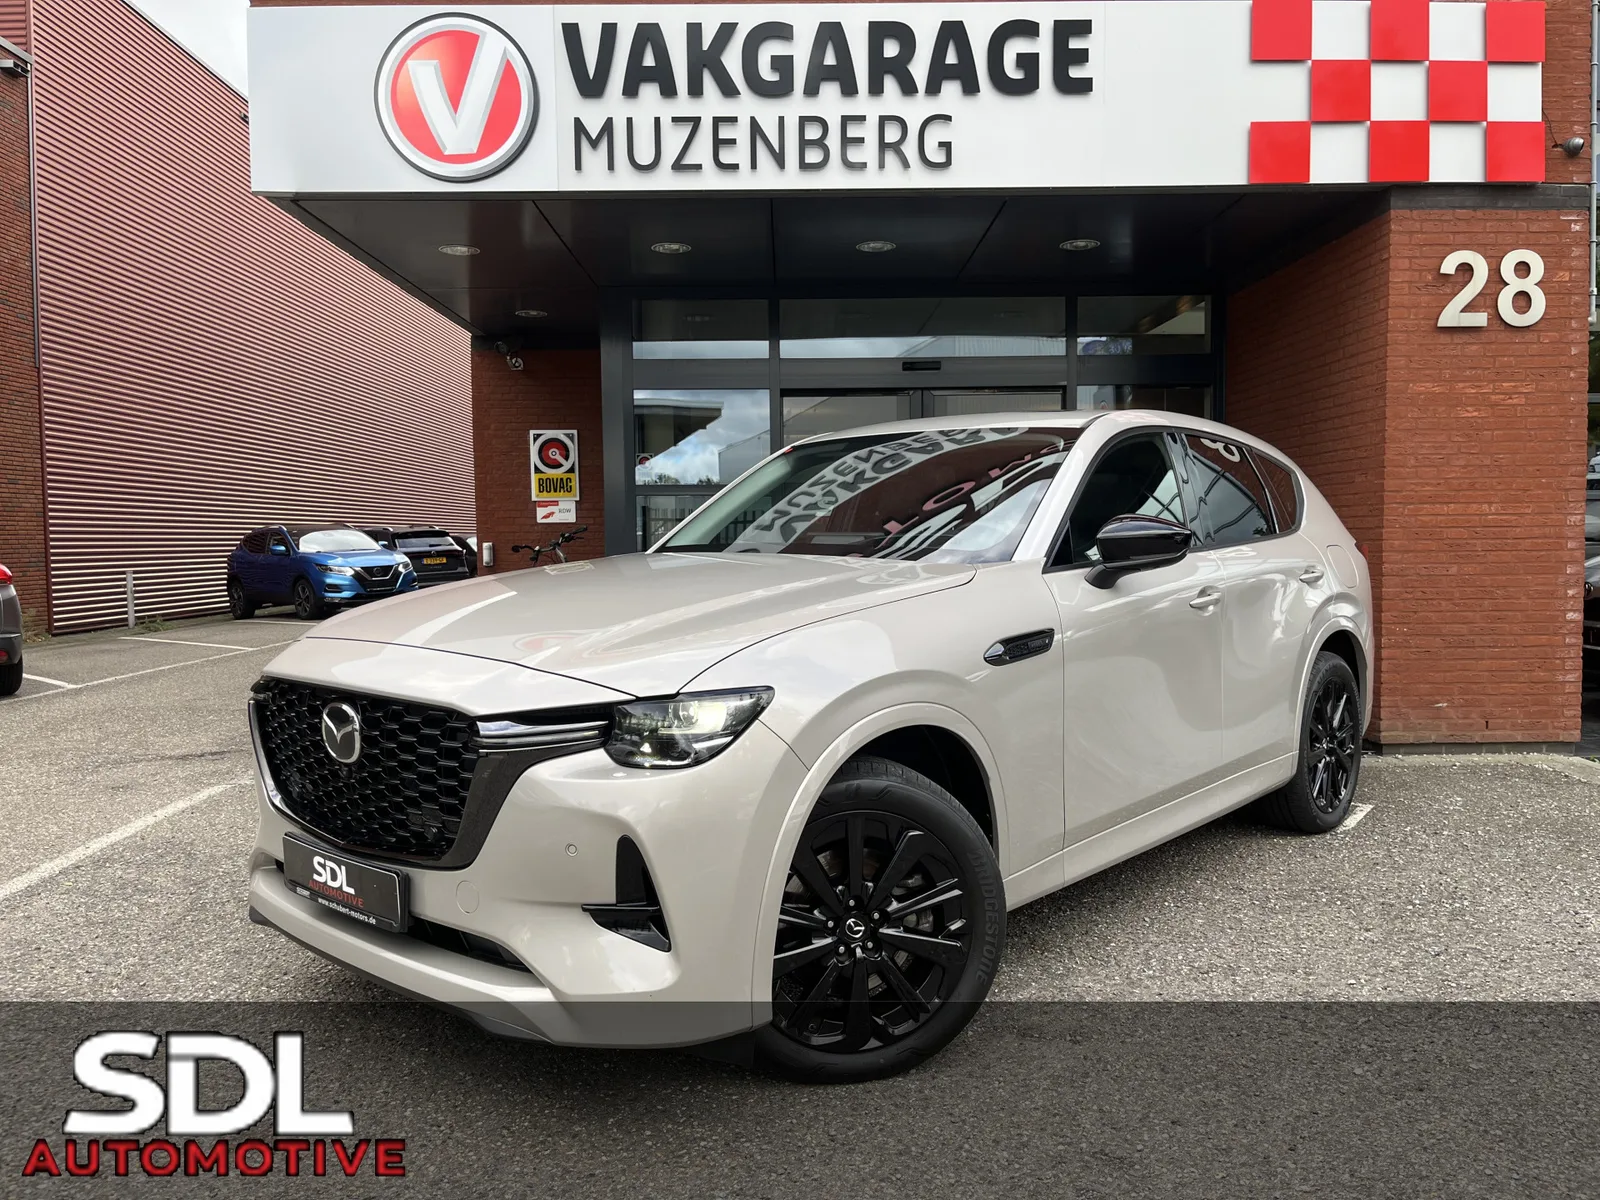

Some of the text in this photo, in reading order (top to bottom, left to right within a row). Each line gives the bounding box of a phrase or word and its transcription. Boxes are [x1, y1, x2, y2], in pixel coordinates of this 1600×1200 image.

[561, 19, 1094, 98] VAKGARAGE
[573, 114, 953, 172] MUZENBERG
[1437, 249, 1546, 327] 28
[308, 880, 364, 908] AUTOMOTIVE
[312, 855, 355, 894] SDL
[317, 897, 377, 925] www.schubert-motors.de
[967, 847, 999, 985] BRIDGESTONE
